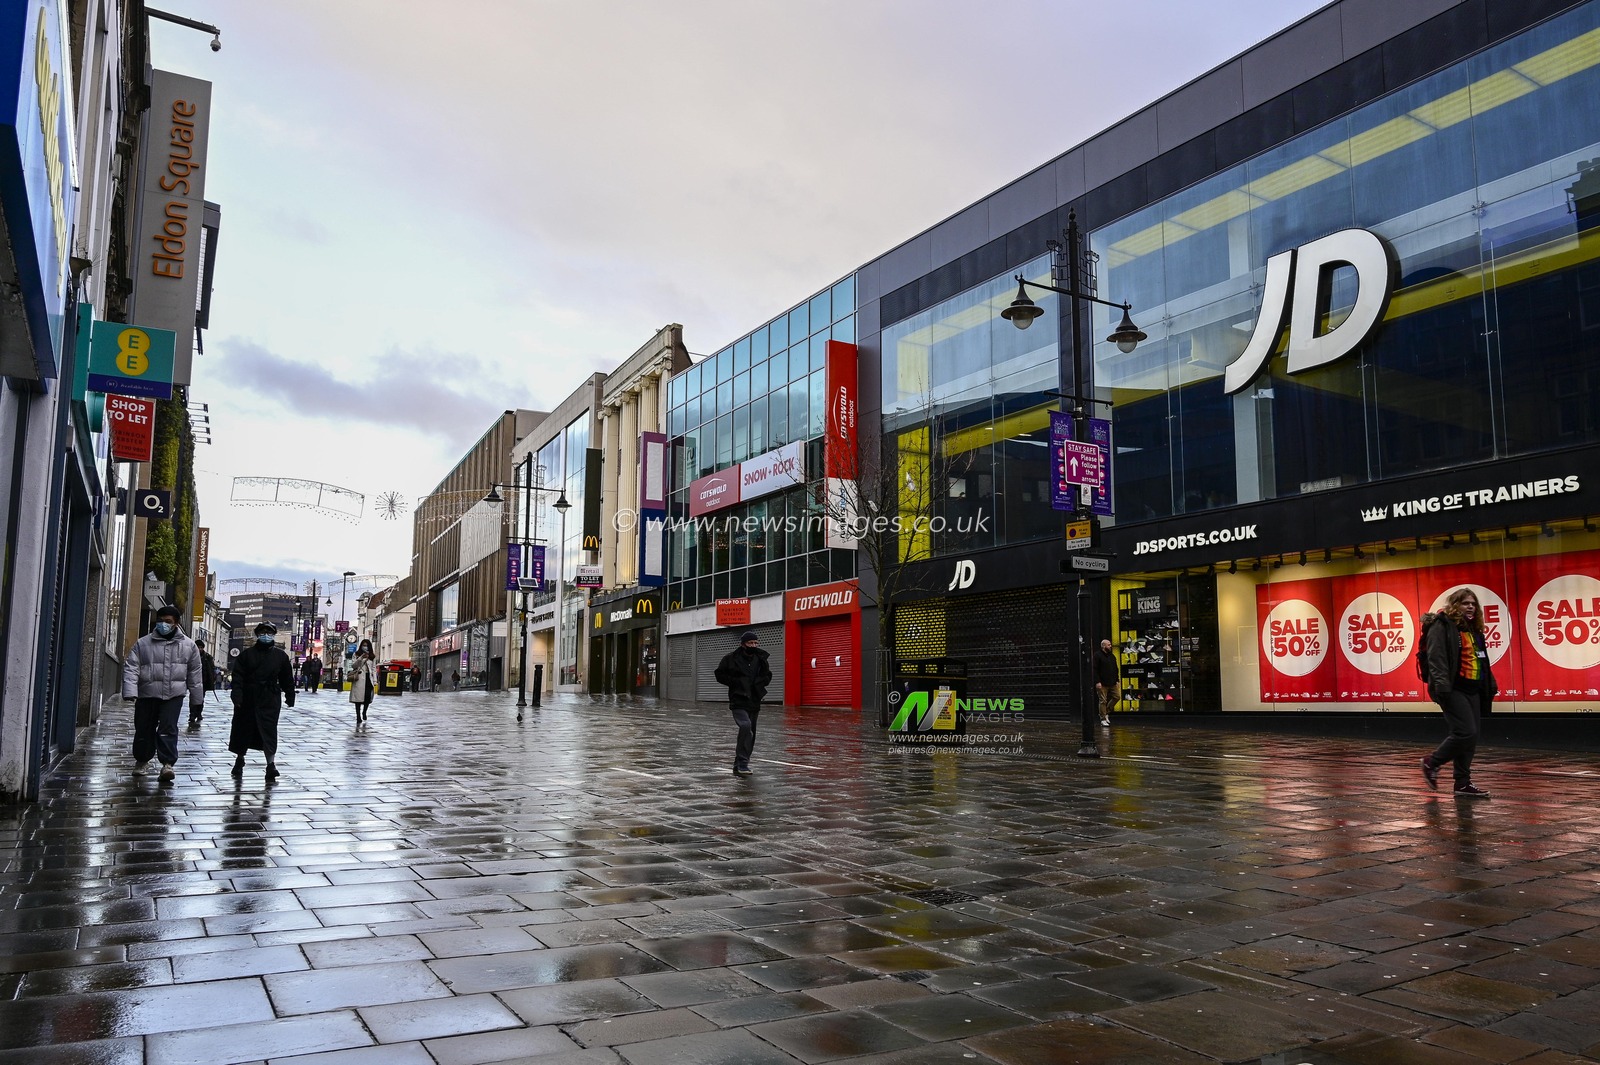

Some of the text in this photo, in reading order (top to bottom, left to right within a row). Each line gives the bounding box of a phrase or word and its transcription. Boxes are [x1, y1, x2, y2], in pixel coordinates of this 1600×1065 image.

[152, 99, 200, 279] Eldon Square
[1224, 227, 1392, 394] JD
[111, 399, 146, 413] SHOP
[107, 409, 148, 425] TO LET
[1067, 443, 1082, 453] STAY
[1082, 446, 1097, 456] SAFE
[1080, 453, 1098, 463] Please
[743, 467, 768, 487] SNOW
[772, 457, 796, 477] ROCK
[1081, 461, 1098, 469] follow
[1085, 468, 1094, 476] the
[1081, 476, 1098, 484] arrows
[699, 483, 727, 500] COTSWOLD
[1393, 475, 1580, 518] KING OF TRAINERS
[705, 497, 721, 508] outdoor
[1132, 524, 1258, 556] JDSPORTS.CO.UK
[198, 530, 209, 578] Sainsbury's Local
[1085, 560, 1106, 569] cycling
[948, 559, 976, 591] JD
[794, 590, 853, 612] COTSWOLD
[1137, 600, 1160, 610] KING
[1270, 617, 1320, 637] SALE
[1347, 611, 1404, 632] SALE
[1537, 622, 1543, 630] TO
[1351, 630, 1405, 654] 50%
[1538, 631, 1543, 640] UP
[1273, 635, 1321, 658] 50%
